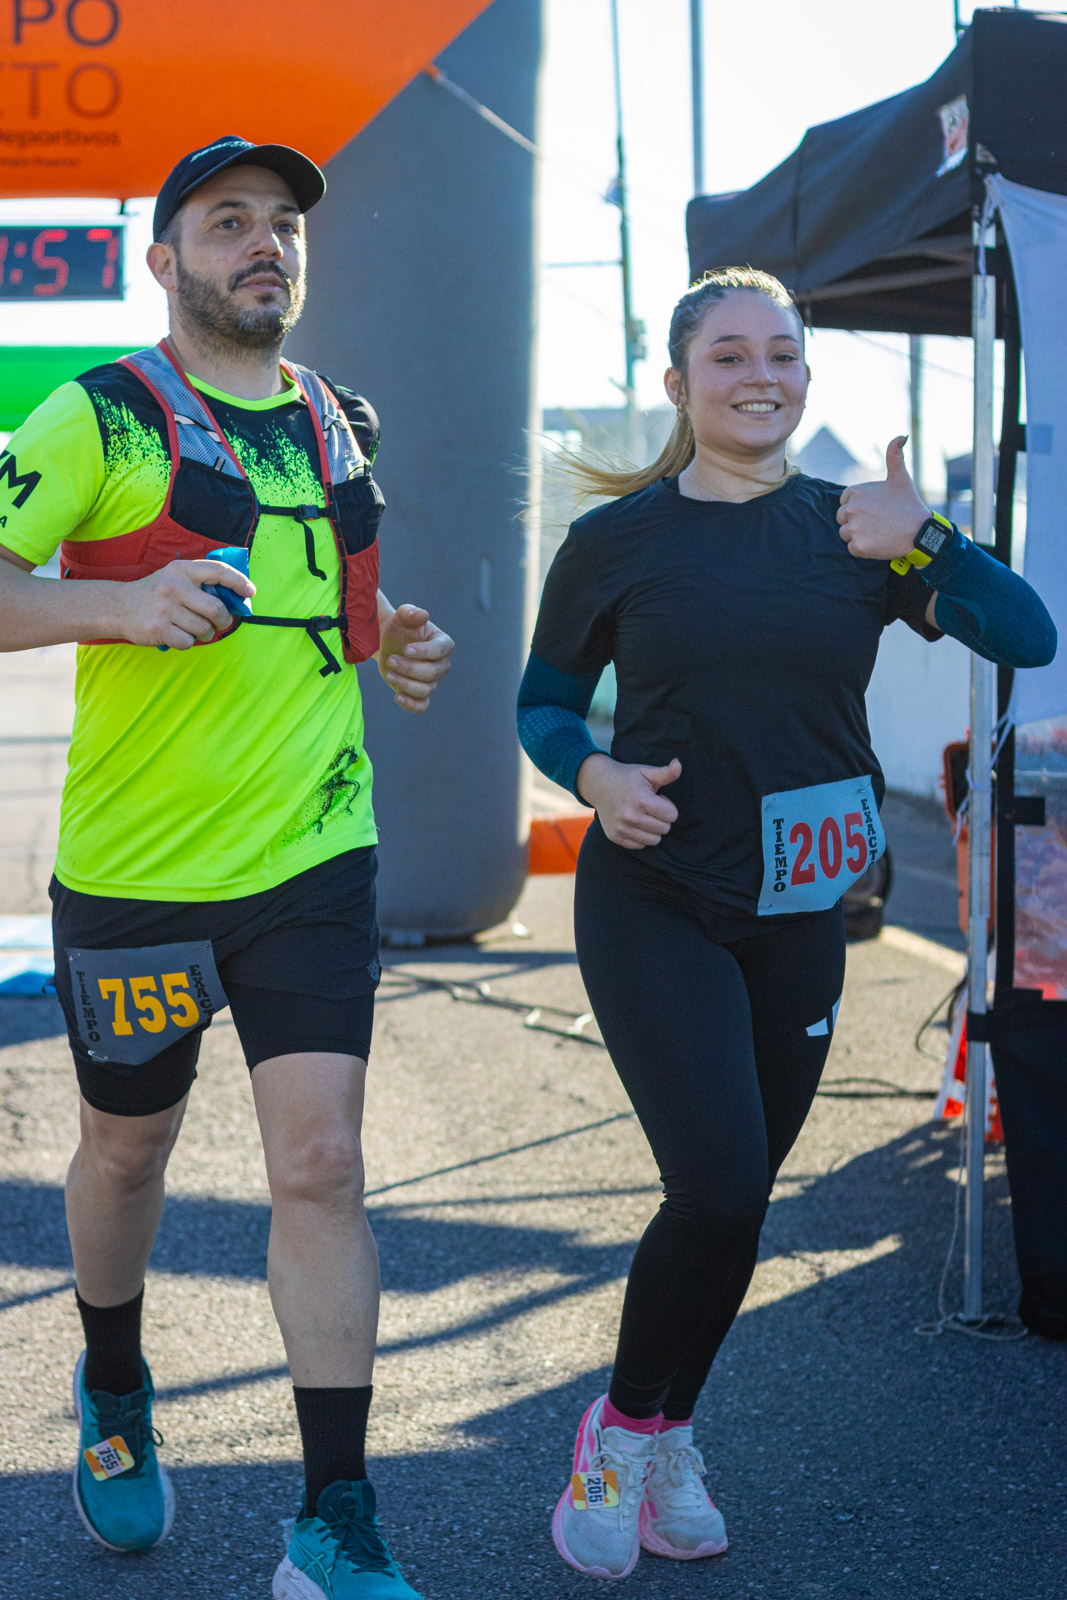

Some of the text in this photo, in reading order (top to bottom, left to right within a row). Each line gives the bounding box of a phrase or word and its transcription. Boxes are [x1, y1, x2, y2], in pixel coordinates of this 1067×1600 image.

[12, 0, 121, 47] PO
[0, 60, 122, 120] TO
[0, 126, 121, 148] eportivos
[0, 450, 42, 509] M
[772, 818, 788, 892] TIEMPO
[788, 810, 868, 886] 205
[75, 970, 100, 1042] TIEMPO
[97, 971, 200, 1036] 755
[98, 1446, 120, 1471] 755
[587, 1477, 603, 1503] 205
